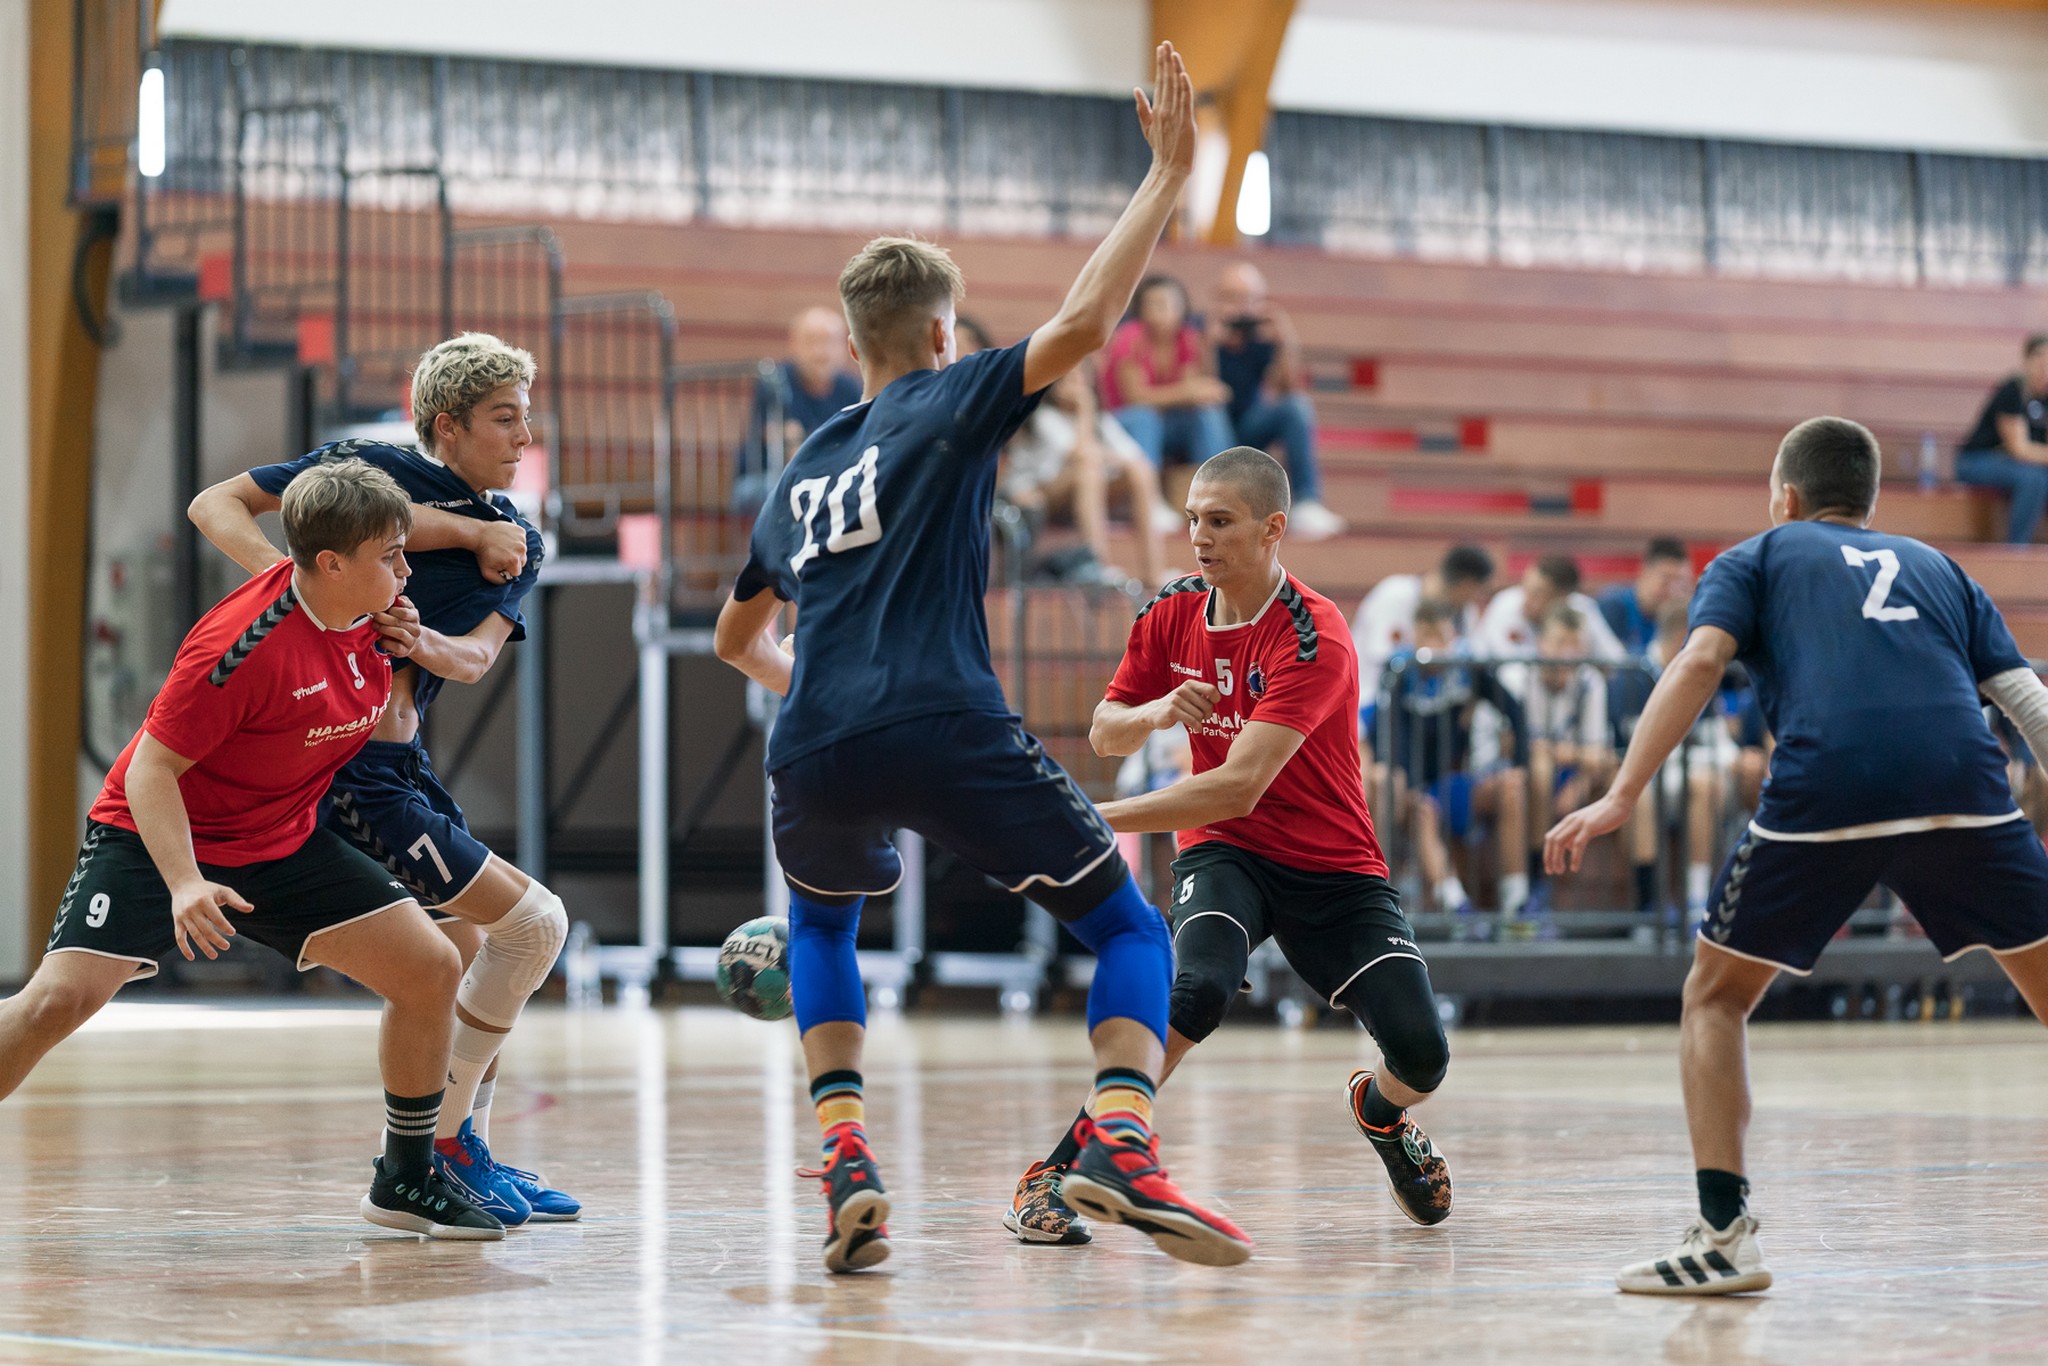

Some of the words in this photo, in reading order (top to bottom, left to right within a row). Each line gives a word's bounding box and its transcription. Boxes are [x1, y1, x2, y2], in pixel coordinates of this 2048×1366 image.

[790, 445, 883, 582] 20
[1840, 545, 1920, 622] 2
[300, 677, 329, 697] hummel
[347, 652, 366, 690] 9
[1214, 658, 1234, 696] 5
[407, 832, 454, 884] 7
[1179, 873, 1195, 905] 5
[85, 892, 111, 928] 9
